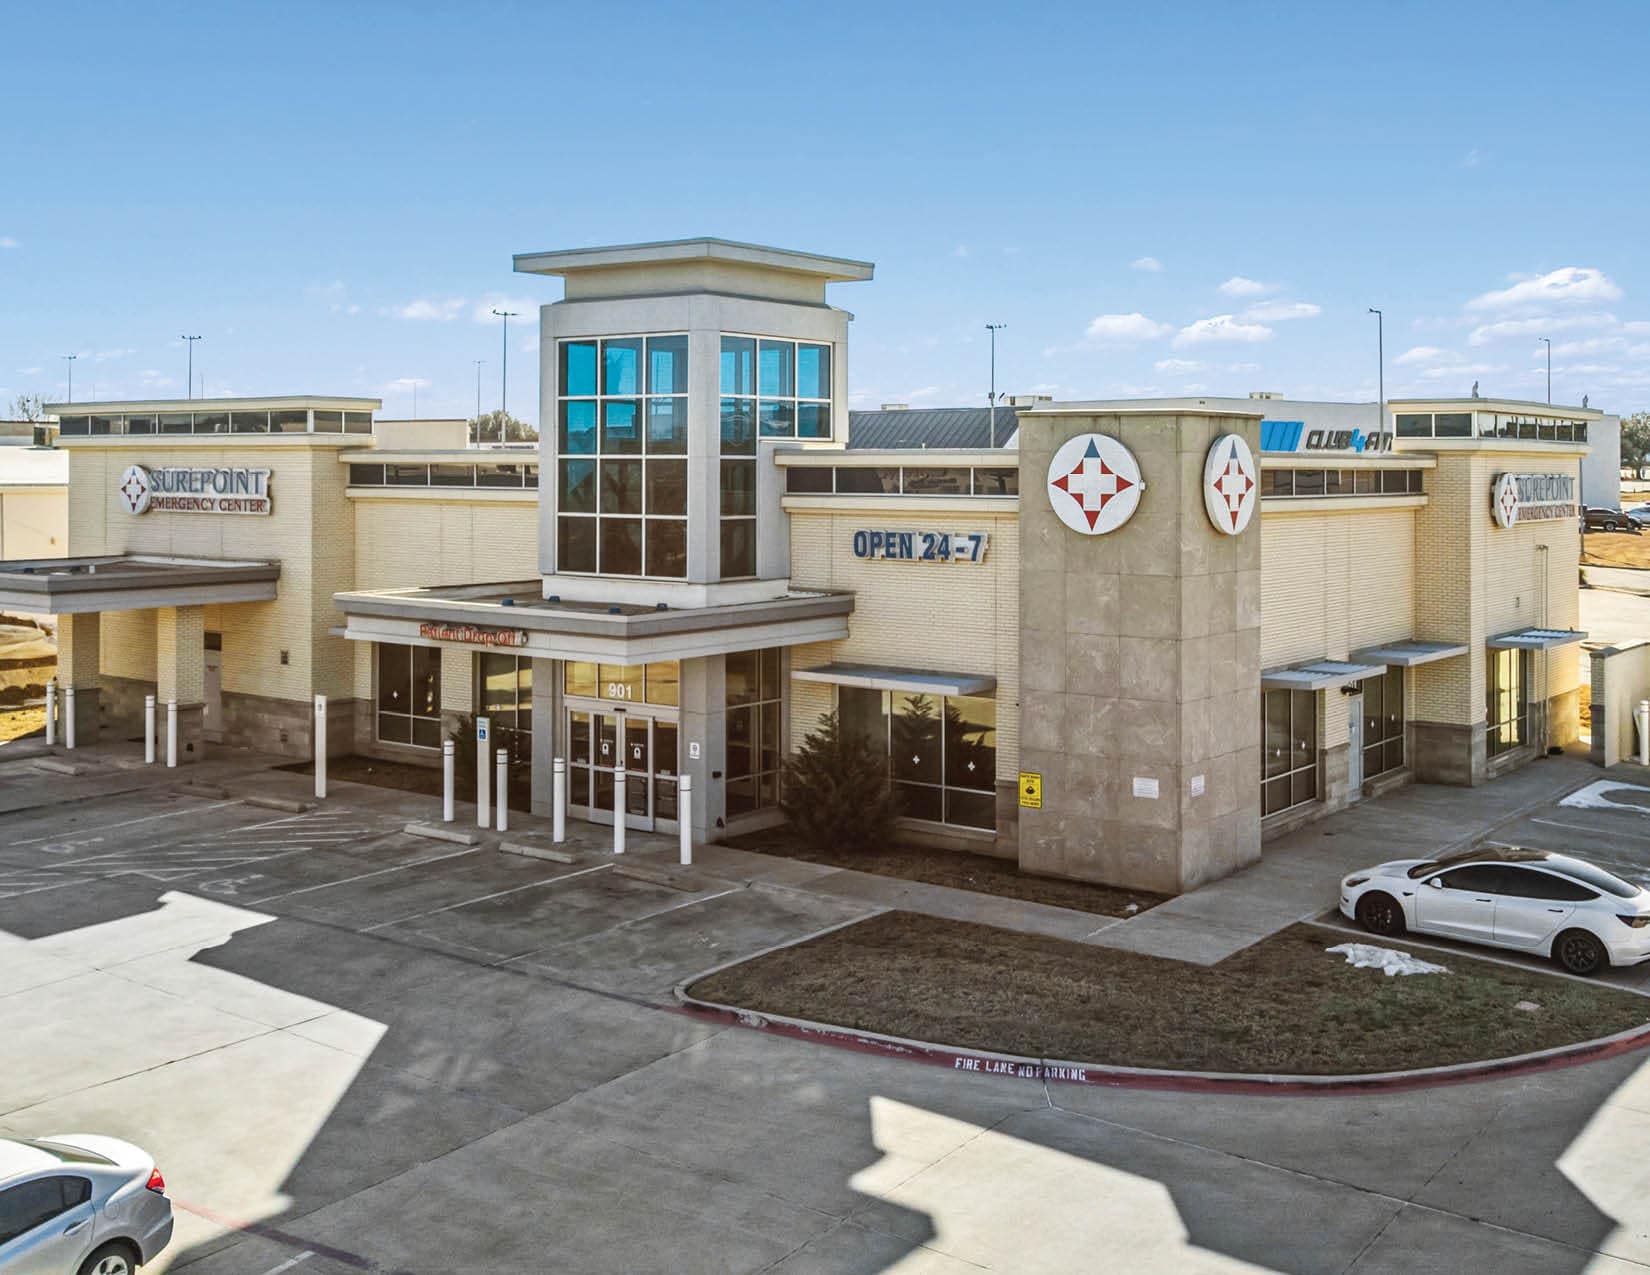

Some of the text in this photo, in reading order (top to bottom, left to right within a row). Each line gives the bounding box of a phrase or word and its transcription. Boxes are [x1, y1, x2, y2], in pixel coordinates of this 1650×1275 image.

[1306, 428, 1393, 453] CLUB4FIT
[151, 470, 262, 494] SUREPOINT
[1518, 477, 1574, 501] SUREPOINT
[151, 497, 265, 512] EMERGENCY CENTER
[853, 530, 982, 562] OPEN 24-7
[420, 624, 460, 641] Patient
[609, 682, 632, 700] 901
[954, 1057, 1086, 1081] FIRE LANE NO PARKING
